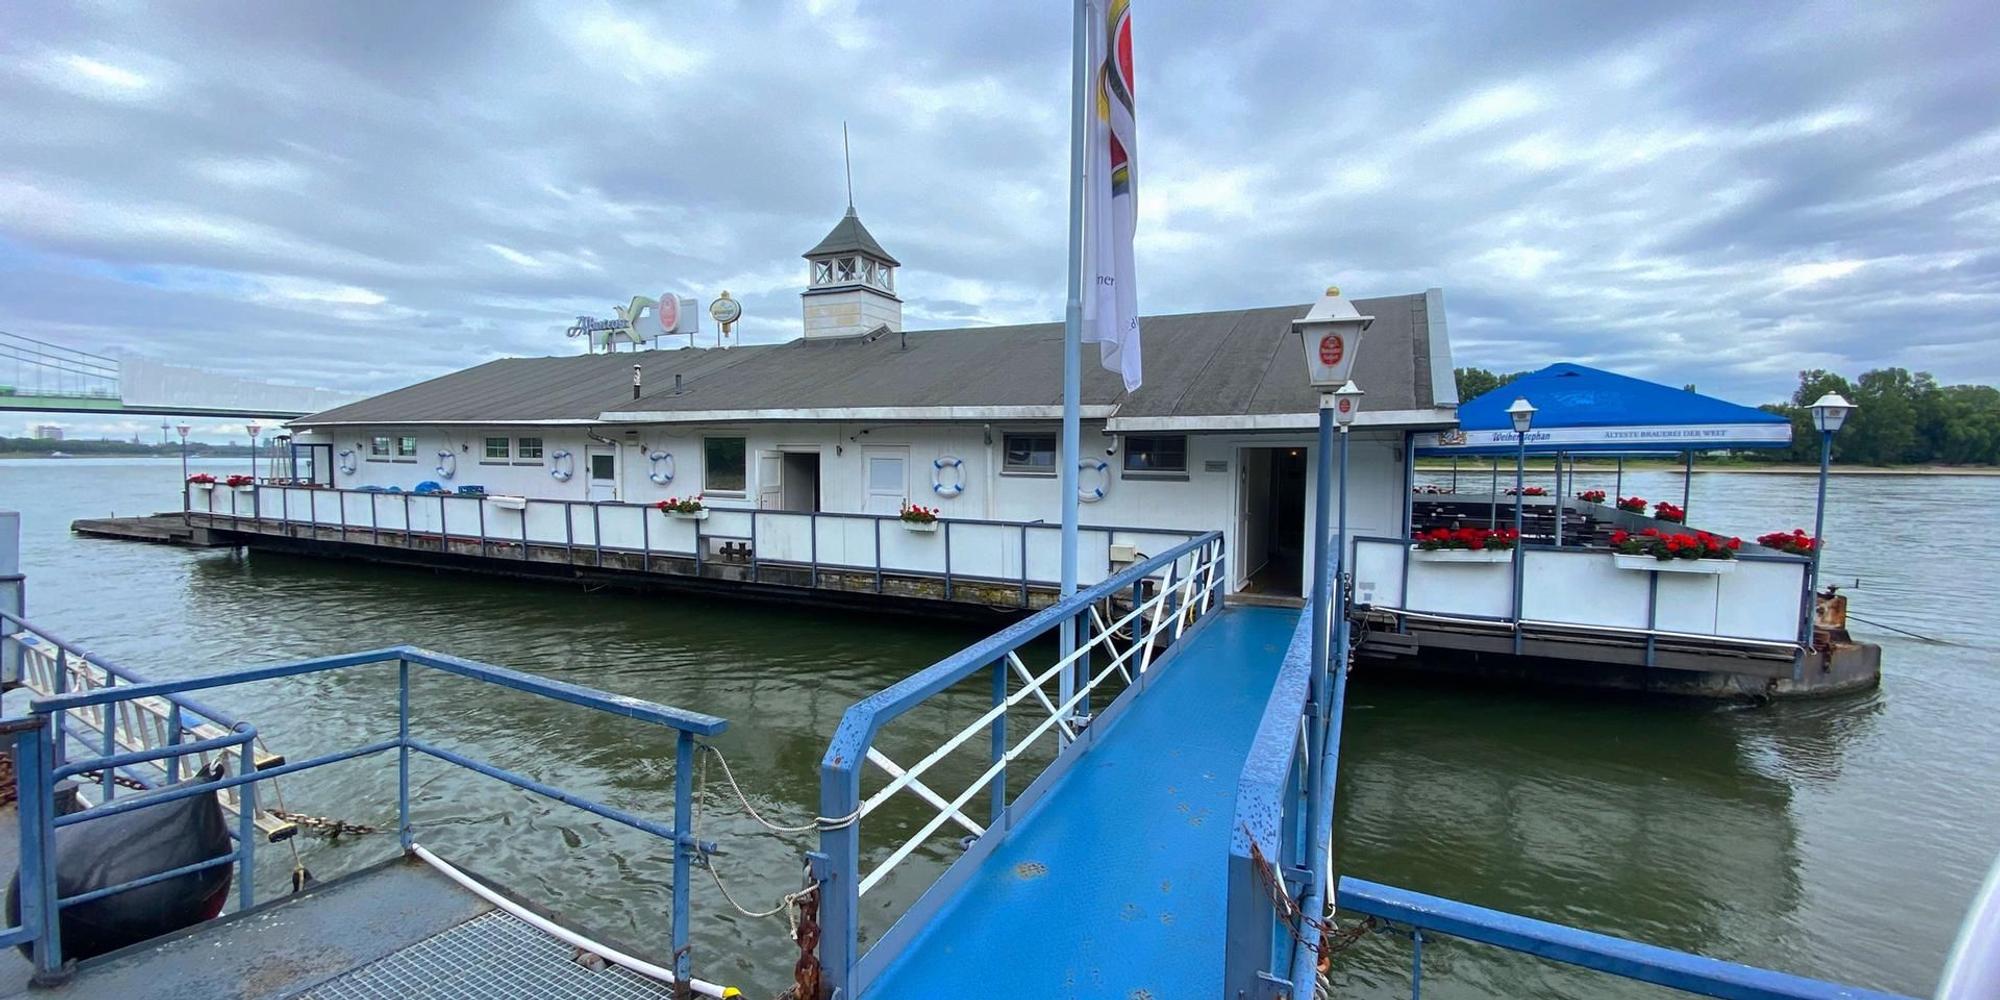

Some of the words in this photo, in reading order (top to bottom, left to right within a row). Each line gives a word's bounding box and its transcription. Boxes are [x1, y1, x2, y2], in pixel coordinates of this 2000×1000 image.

[1641, 430, 1681, 438] BRAUEREI
[1683, 429, 1701, 437] DER
[1702, 429, 1727, 437] WELT
